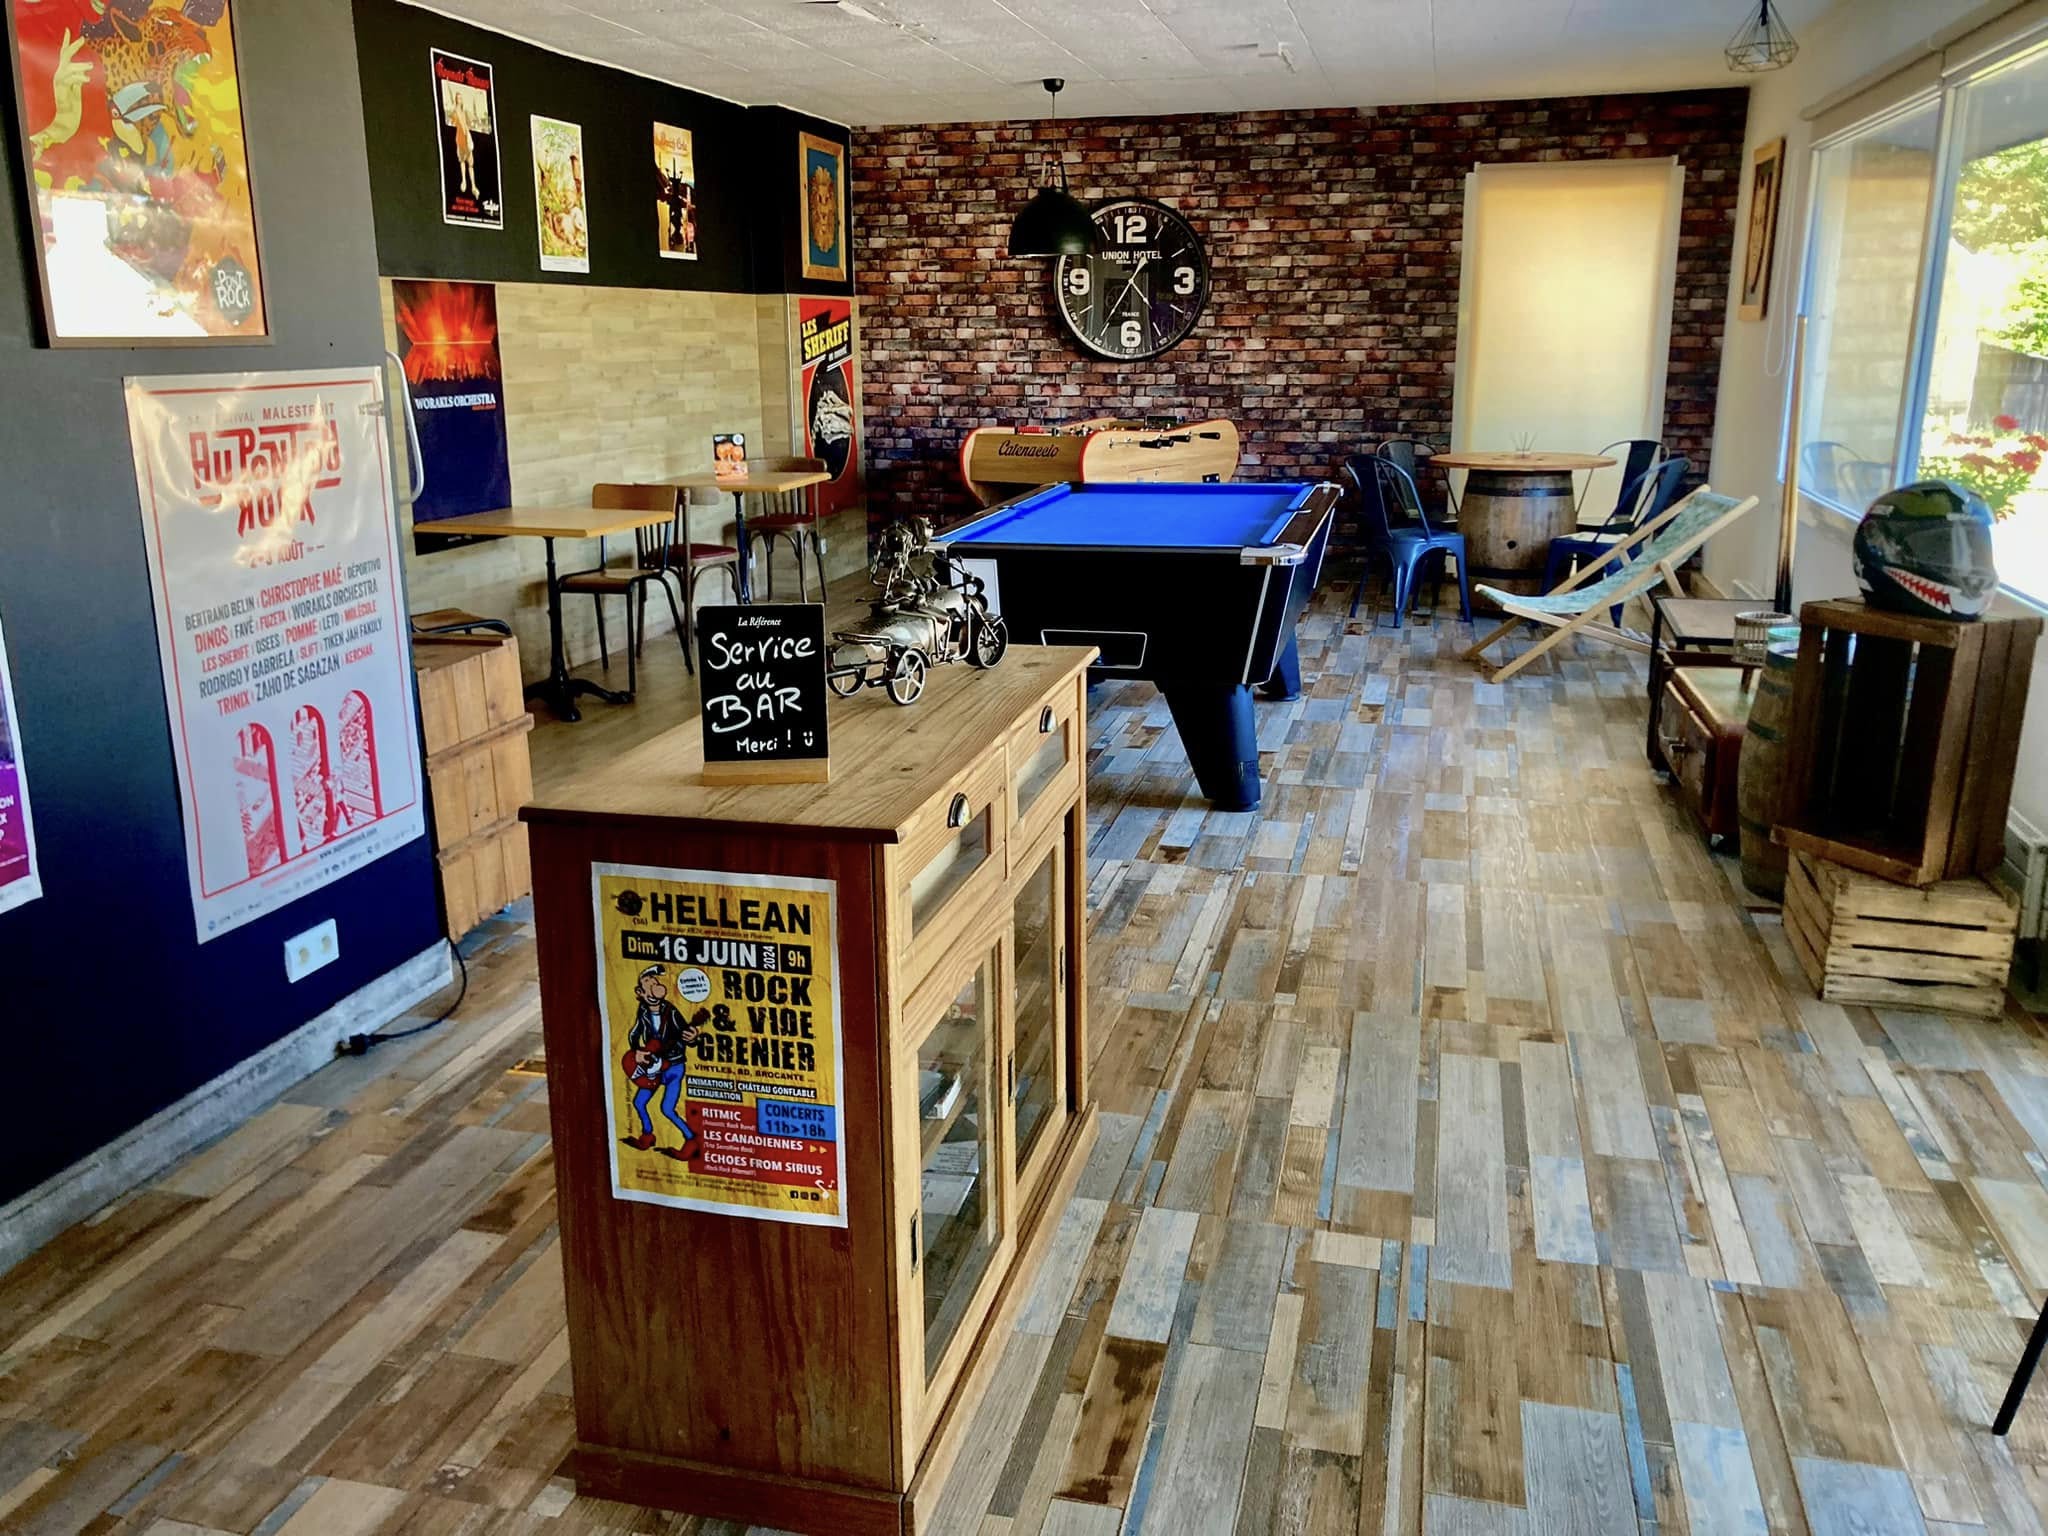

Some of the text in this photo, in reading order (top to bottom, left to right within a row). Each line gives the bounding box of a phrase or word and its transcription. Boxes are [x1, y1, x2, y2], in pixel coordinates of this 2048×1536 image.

[1114, 215, 1147, 243] 12
[1102, 250, 1163, 260] UNION HOTEL
[1069, 268, 1090, 296] 9
[1173, 266, 1195, 295] 3
[216, 286, 250, 308] ROCK
[802, 318, 817, 339] LES
[804, 320, 849, 361] SHERIFF
[1120, 320, 1142, 348] 6
[414, 393, 496, 410] WORAKLS ORCHESTRA
[998, 440, 1060, 458] Catenaccio
[185, 604, 230, 631] BERTRAND
[230, 595, 255, 617] BELIN
[260, 572, 322, 608] CHRISTOPHE
[322, 562, 343, 589] MAÉ
[194, 578, 378, 654] DINOS FAVÉ FUZETA WORAKLS ORCHESTRA
[738, 616, 782, 629] La Référence
[201, 656, 218, 673] LES
[255, 633, 281, 654] OSEES
[285, 618, 318, 645] POMME
[322, 612, 340, 631] LETO
[707, 632, 816, 670] Service
[199, 668, 242, 699] RODRIGO
[243, 665, 250, 682] Y
[251, 649, 295, 680] GABRIELA
[323, 632, 344, 651] TIKEN
[345, 625, 359, 643] JAH
[359, 616, 383, 636] FAKOLY
[216, 689, 250, 717] TRINIX
[255, 675, 282, 702] ZAHO
[283, 670, 297, 691] DE
[297, 653, 340, 685] SAGAZAN
[736, 671, 775, 691] au
[706, 687, 802, 733] BAR
[736, 737, 777, 753] Merci
[650, 891, 811, 936] HELLEAN
[627, 936, 806, 970] Dim. 16 JUIN 2024 9h
[722, 969, 812, 1006] ROCK
[712, 1003, 815, 1039] & VIDE
[697, 1032, 815, 1072] GRENIER
[687, 1077, 733, 1090] ANIMATIONS
[737, 1081, 816, 1098] CHÂTEAU GONFLABLE
[755, 1070, 804, 1081] BROCANTE
[687, 1087, 741, 1101] RESTAURATION
[702, 1107, 741, 1121] RITMIC
[765, 1103, 825, 1121] CONCERTS
[703, 1130, 722, 1141] LES
[725, 1132, 804, 1151] CANADIENNES
[704, 1150, 748, 1167] ÉCHOES
[749, 1158, 782, 1171] FROM
[784, 1163, 823, 1176] SIRIUS
